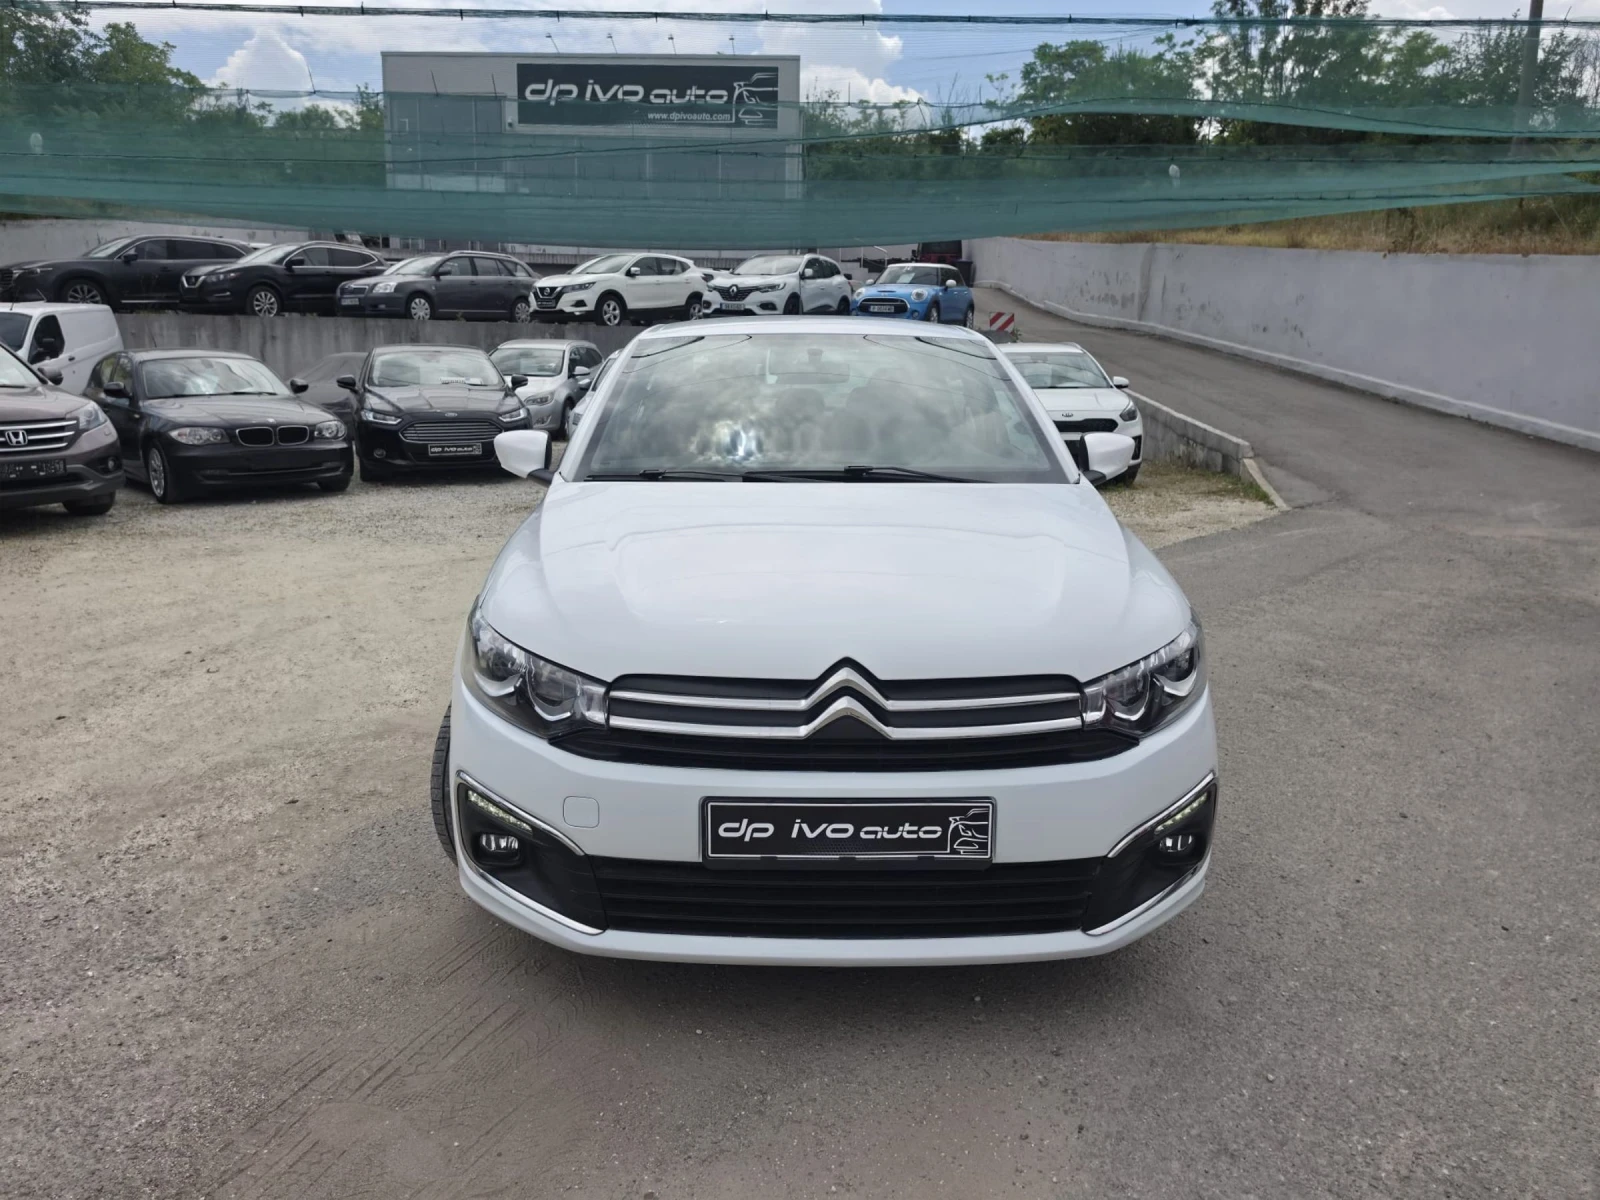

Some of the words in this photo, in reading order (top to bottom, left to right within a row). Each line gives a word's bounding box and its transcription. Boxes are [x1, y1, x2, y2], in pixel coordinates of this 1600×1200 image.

[525, 79, 577, 106] dp
[585, 79, 645, 102] ivo
[650, 85, 728, 104] auto
[647, 111, 731, 122] www.dpivoauto.com
[718, 818, 774, 841] dp
[791, 818, 855, 839] ivo
[859, 822, 942, 840] auto
